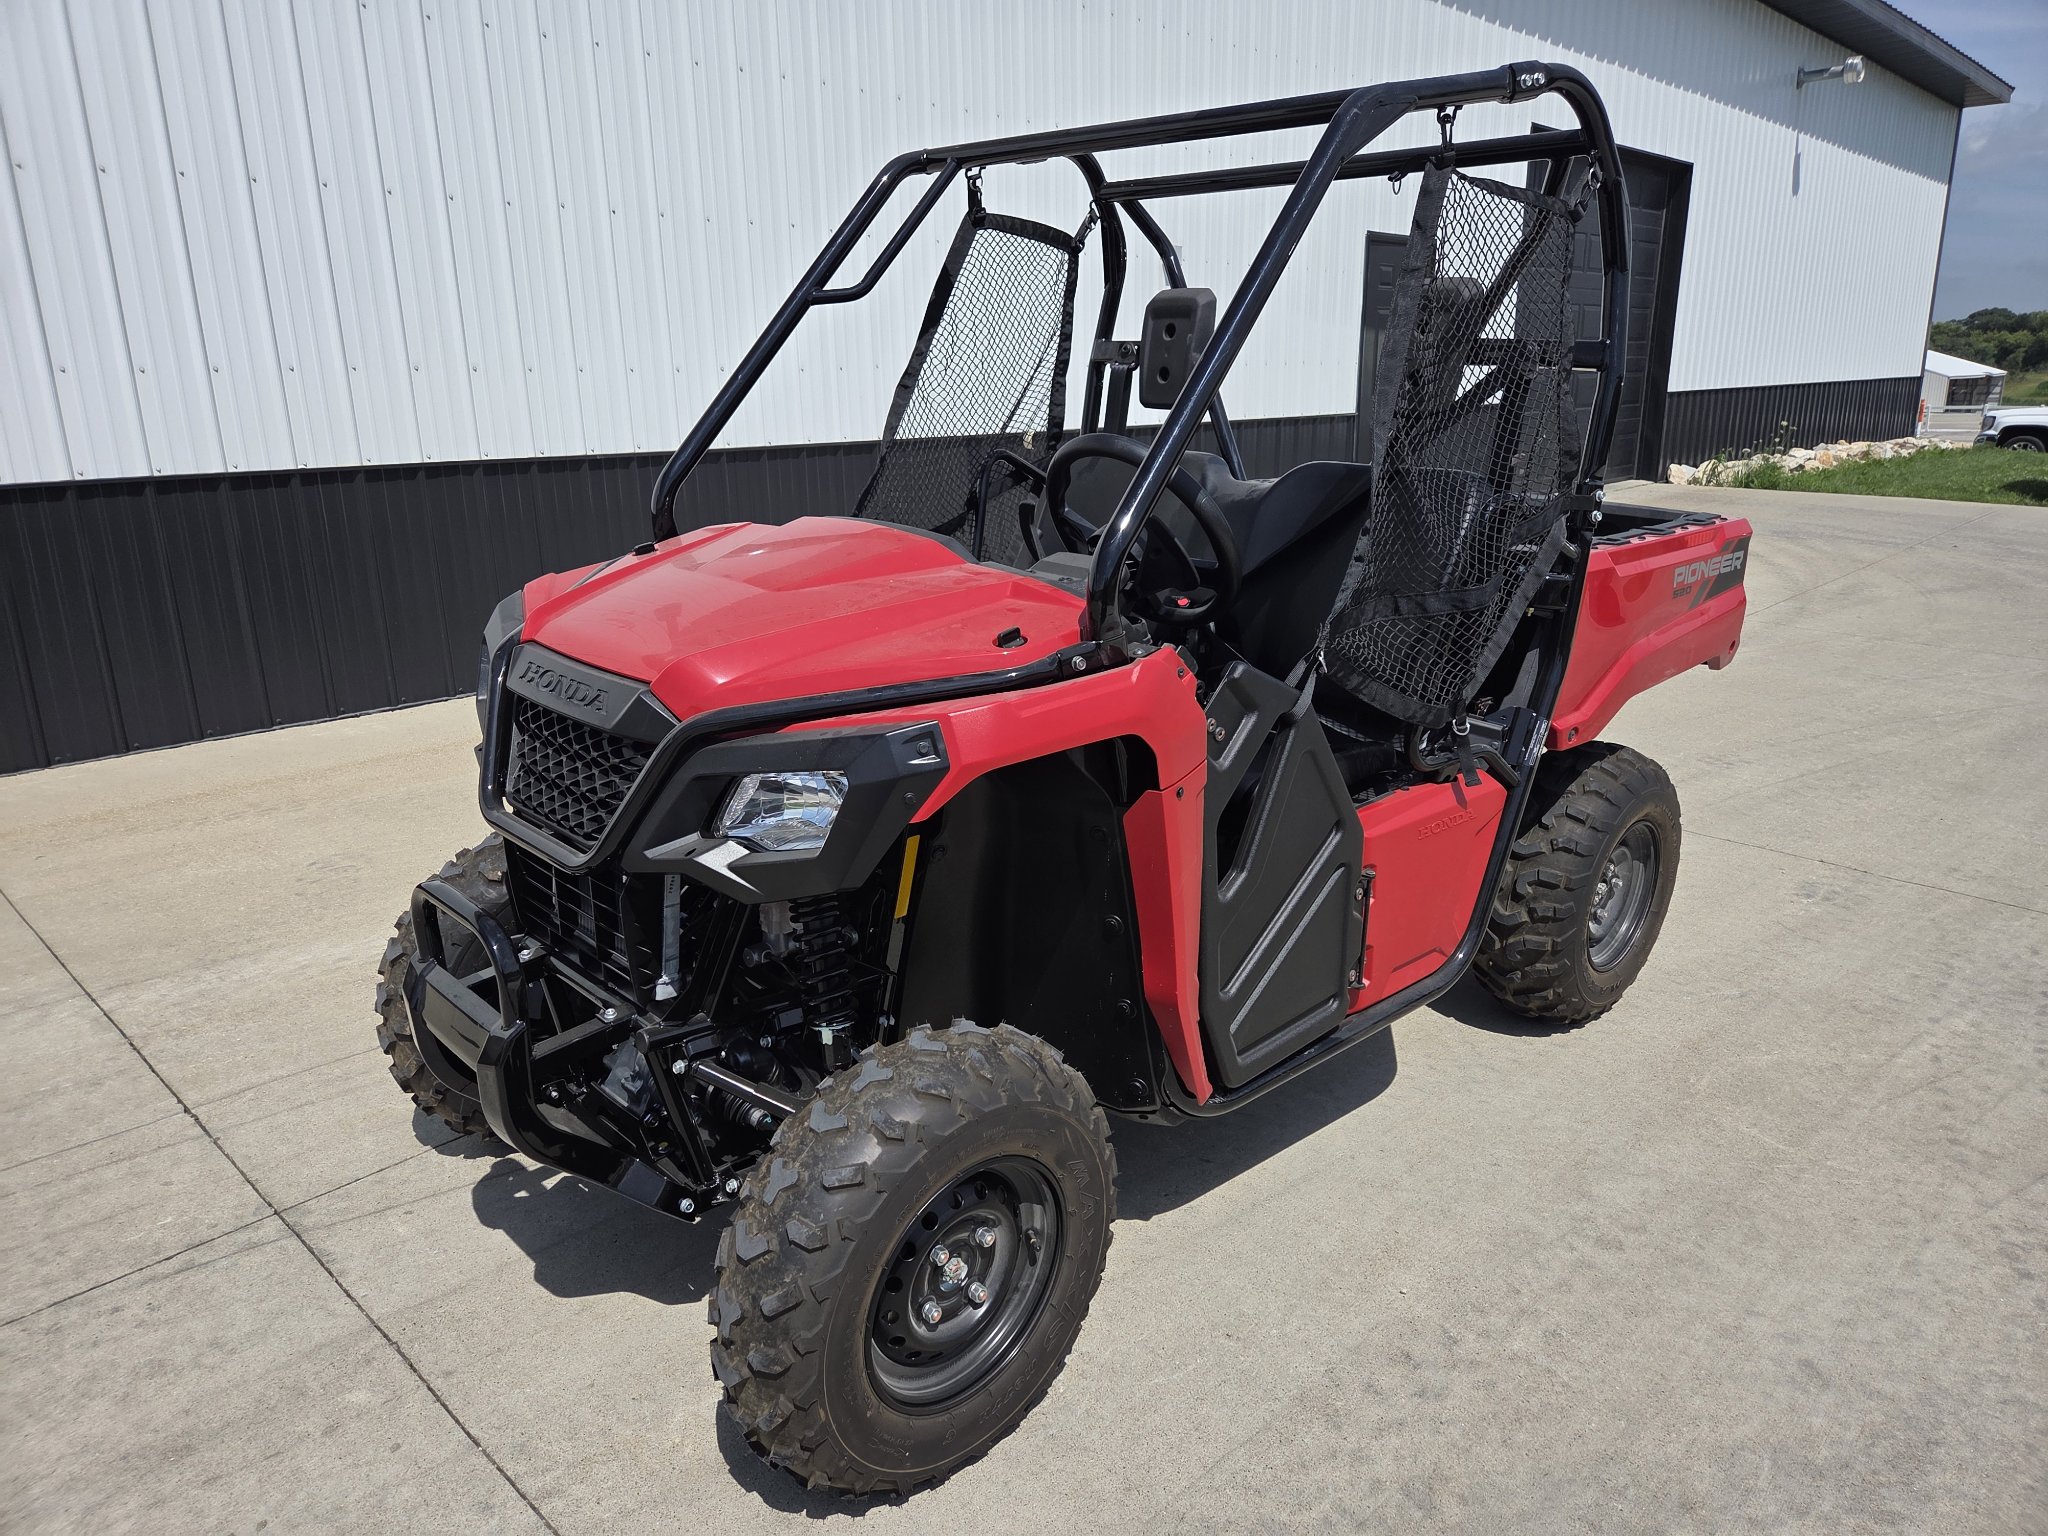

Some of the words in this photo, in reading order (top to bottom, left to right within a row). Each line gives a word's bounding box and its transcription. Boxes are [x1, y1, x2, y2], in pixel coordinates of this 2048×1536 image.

[1673, 550, 1745, 588] PIONEER
[1672, 585, 1693, 599] 520
[519, 661, 609, 716] HONDA
[1417, 808, 1477, 841] HONDA
[1044, 1158, 1102, 1352] MAXXIS
